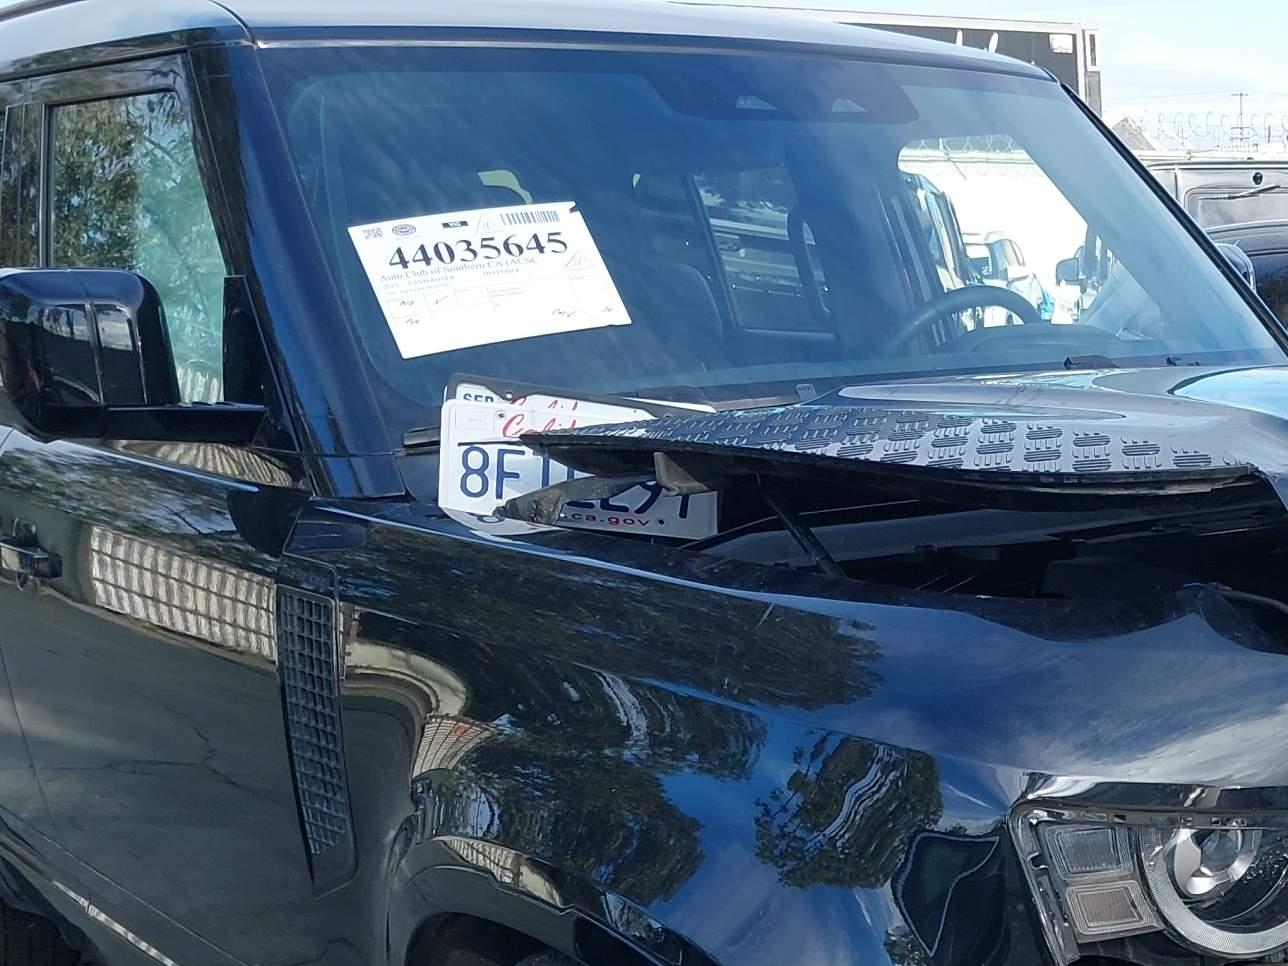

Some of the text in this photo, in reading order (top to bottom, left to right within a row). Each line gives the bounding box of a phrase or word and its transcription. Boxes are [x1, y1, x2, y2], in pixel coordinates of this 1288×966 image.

[388, 231, 568, 270] 44035645
[380, 271, 403, 282] Auto
[405, 267, 429, 278] Club
[430, 265, 443, 275] of
[443, 261, 486, 273] Southern
[487, 258, 504, 269] CA
